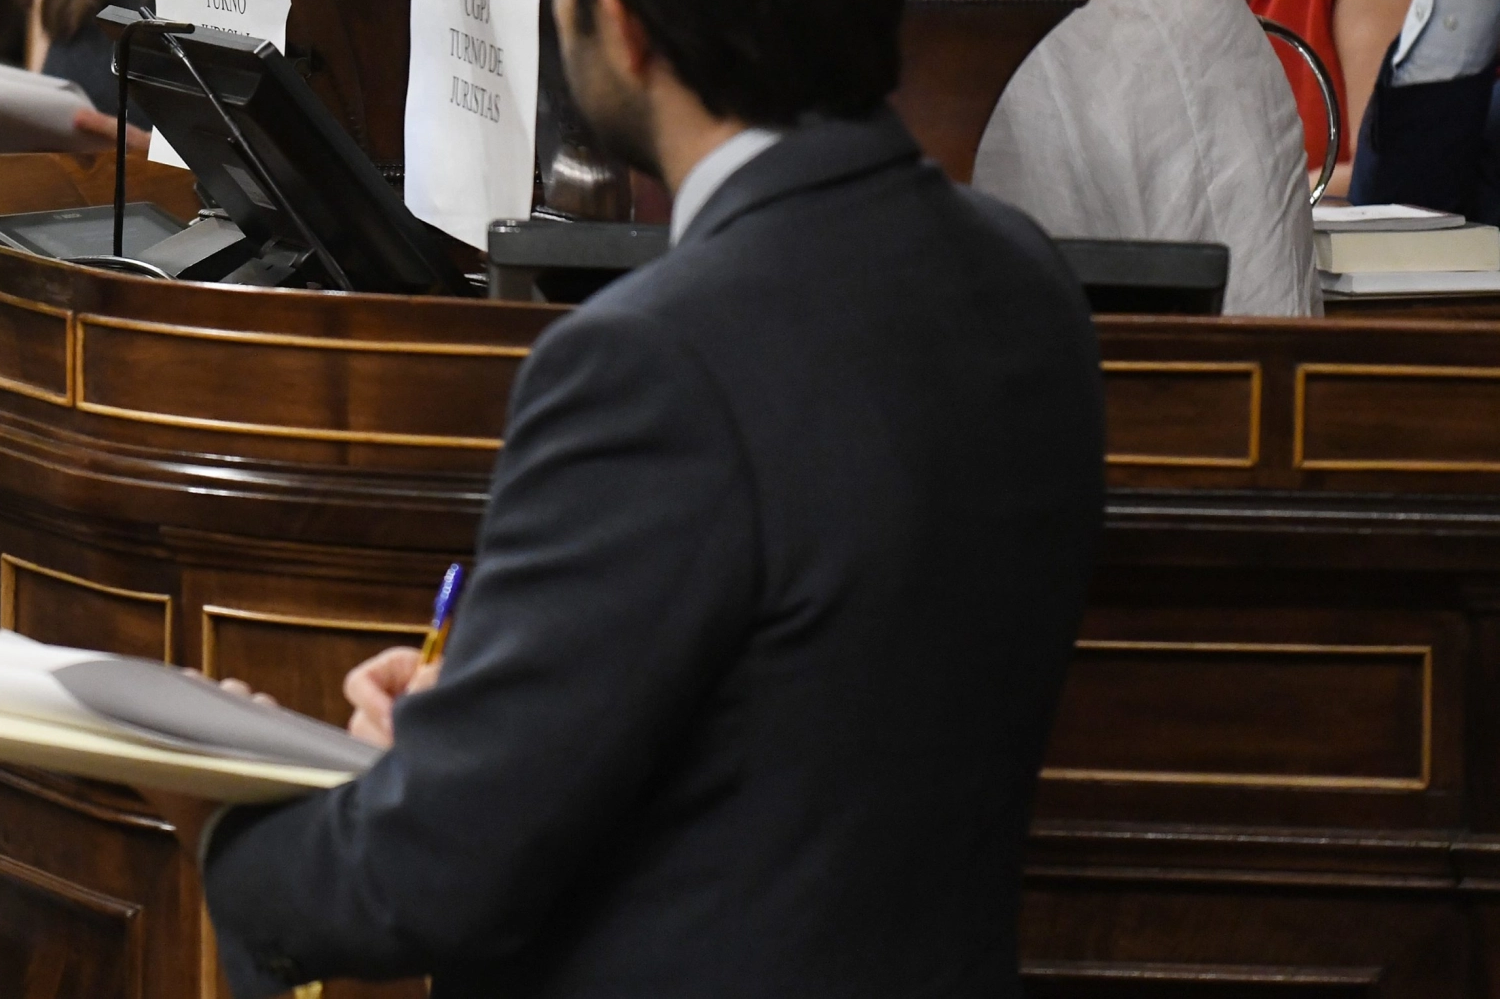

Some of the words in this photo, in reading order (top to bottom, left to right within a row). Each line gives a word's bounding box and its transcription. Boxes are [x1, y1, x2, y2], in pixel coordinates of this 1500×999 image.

[449, 27, 487, 69] TURNO
[488, 44, 504, 77] DE
[449, 75, 501, 124] JURISTAS
